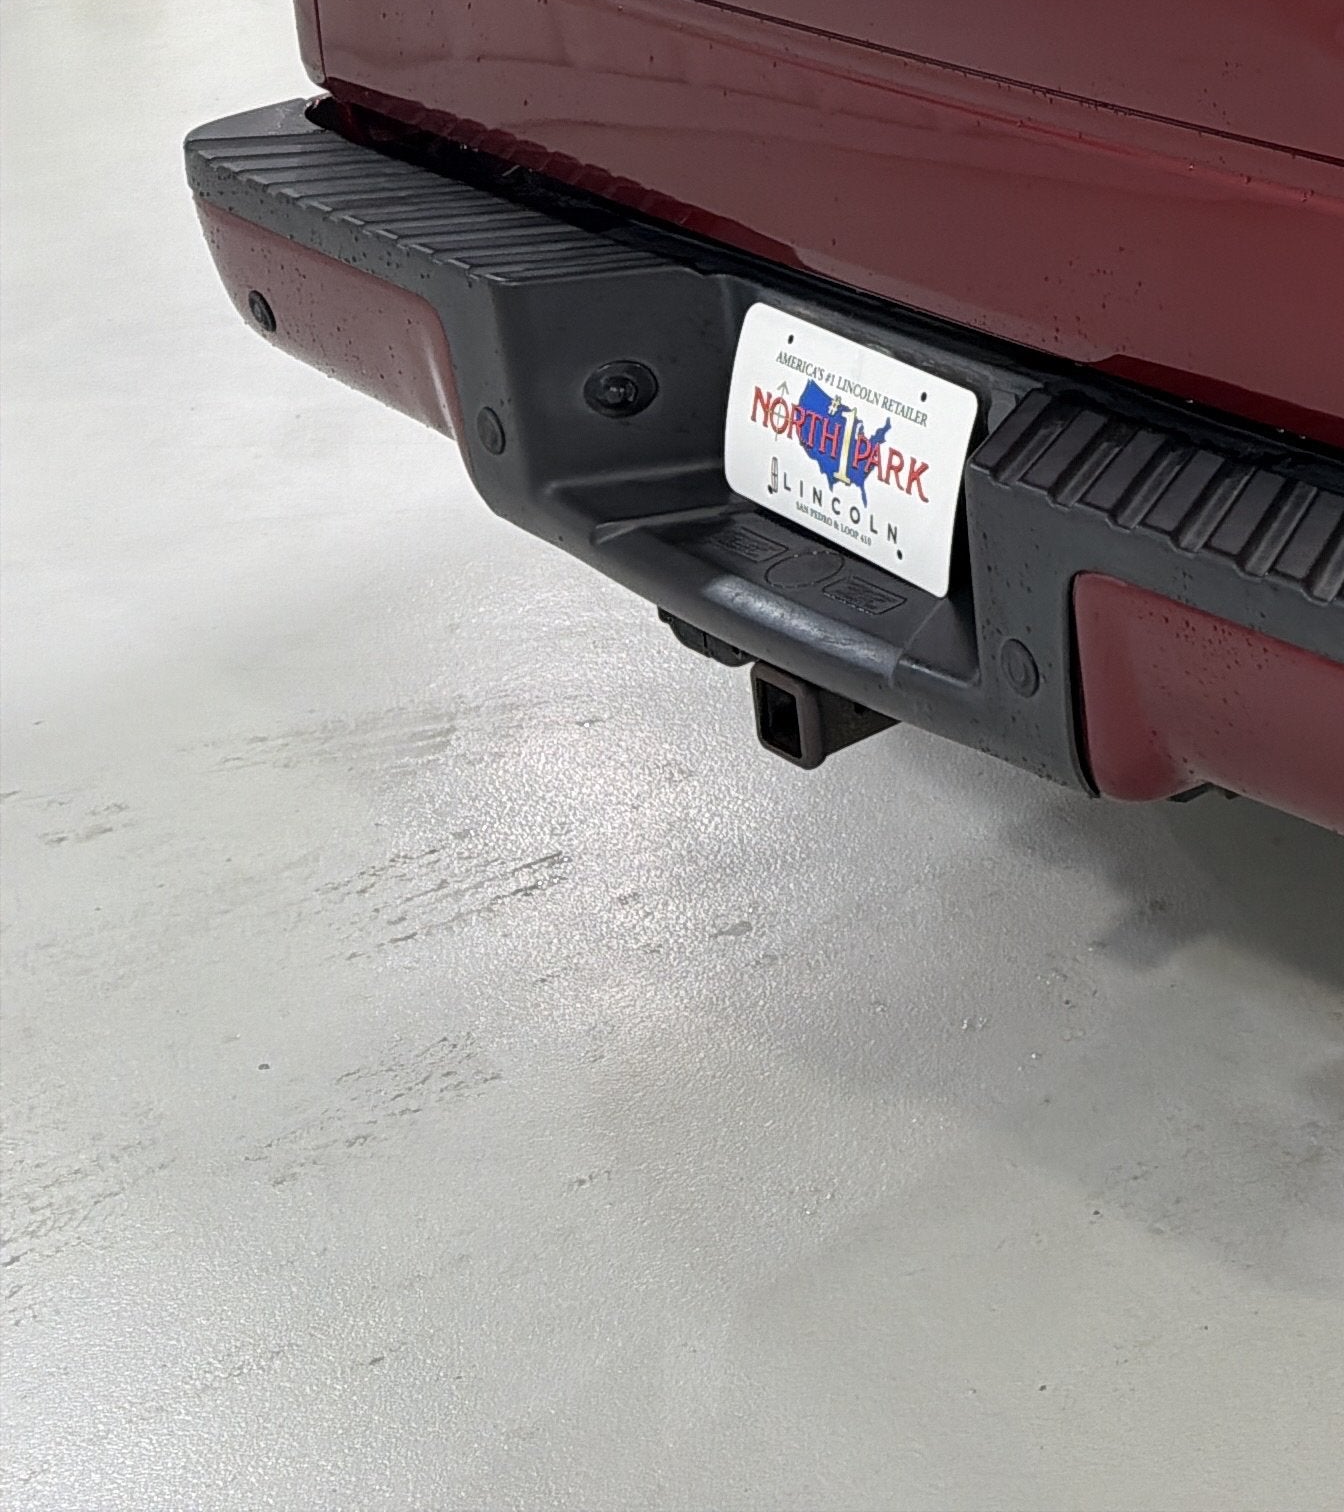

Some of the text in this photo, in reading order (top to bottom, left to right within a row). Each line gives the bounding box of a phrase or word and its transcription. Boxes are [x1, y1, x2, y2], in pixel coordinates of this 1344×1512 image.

[775, 351, 825, 381] AMERICA'S
[836, 377, 881, 406] LINCOLN
[880, 396, 928, 428] RETAILER
[750, 386, 930, 504] NORTH PARK
[783, 471, 898, 544] LINCOLN
